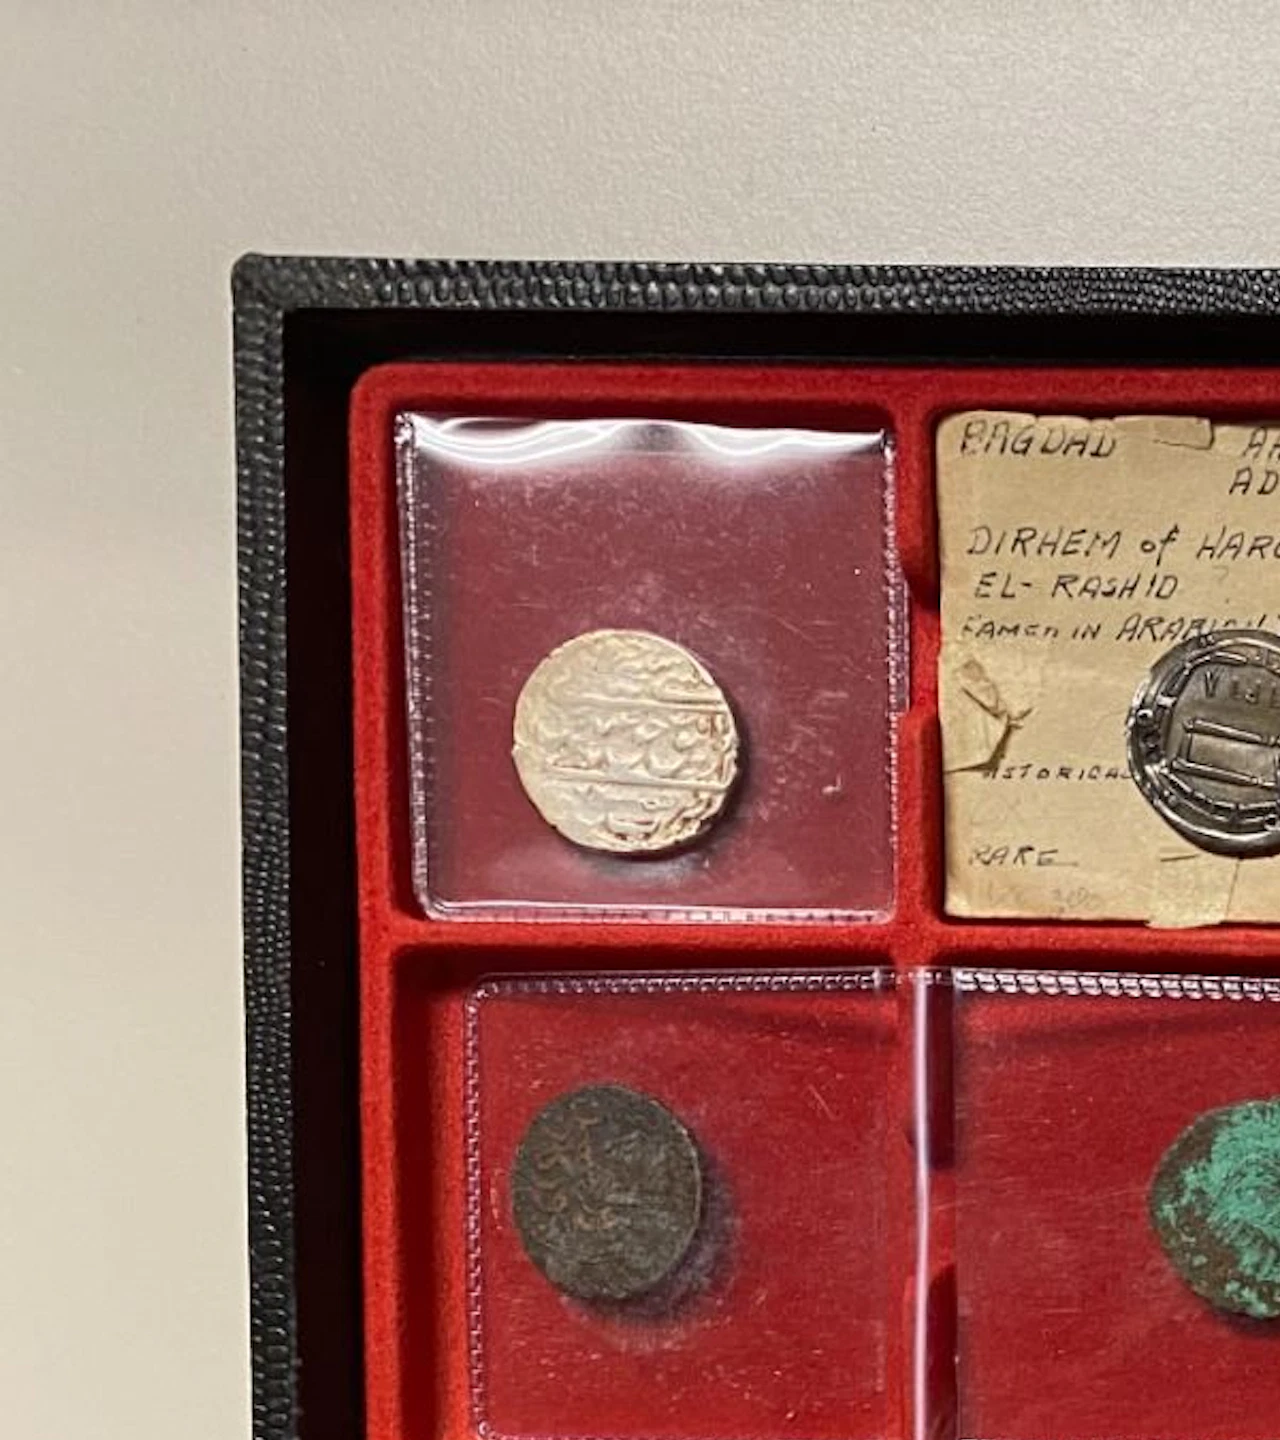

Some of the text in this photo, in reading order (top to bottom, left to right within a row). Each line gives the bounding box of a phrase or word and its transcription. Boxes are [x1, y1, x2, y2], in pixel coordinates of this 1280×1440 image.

[966, 526, 1120, 558] DIRHEM
[1141, 524, 1178, 566] of
[1051, 570, 1178, 600] RASHID
[1071, 621, 1102, 641] IN
